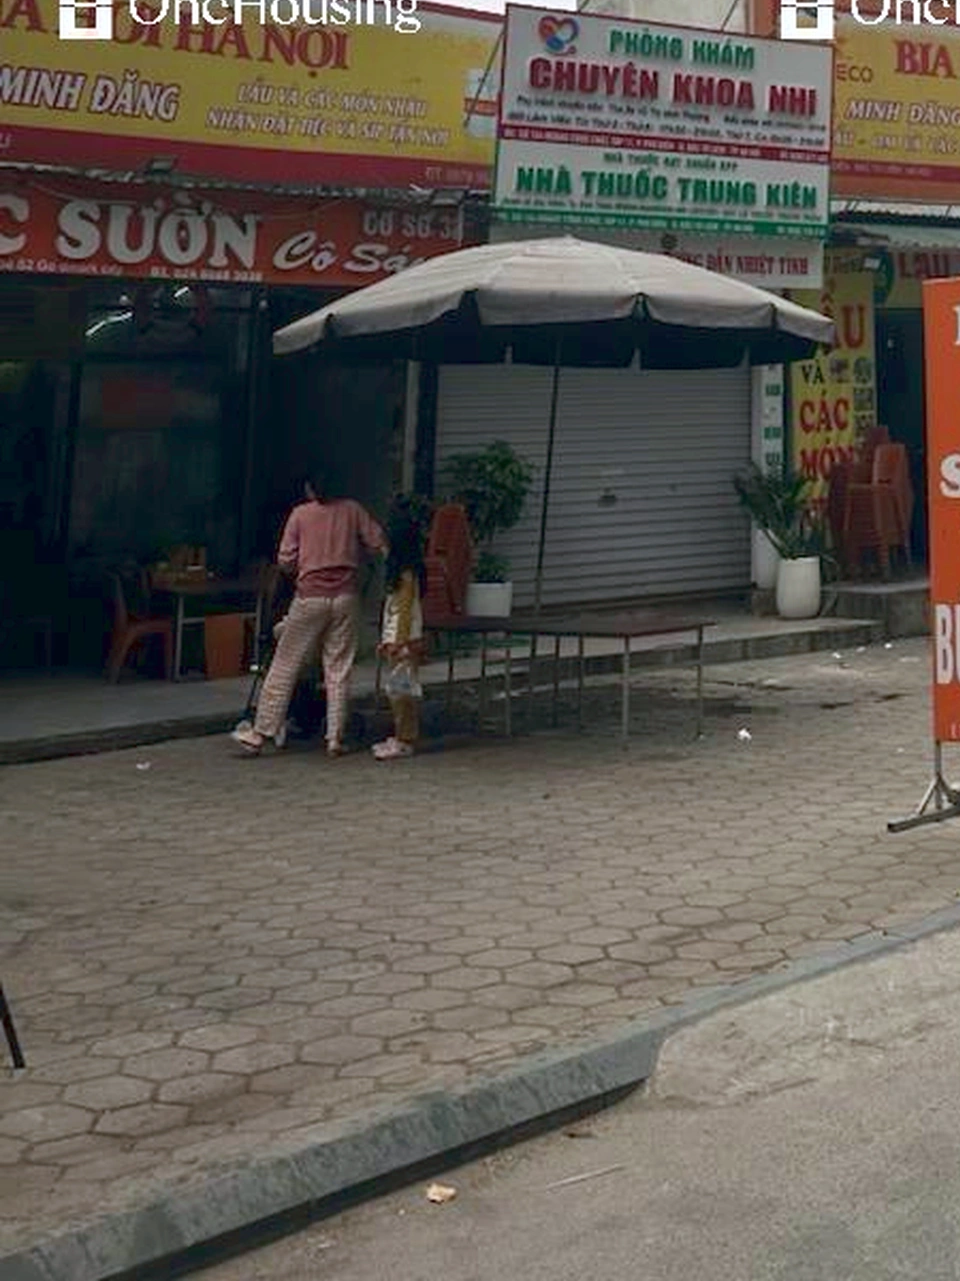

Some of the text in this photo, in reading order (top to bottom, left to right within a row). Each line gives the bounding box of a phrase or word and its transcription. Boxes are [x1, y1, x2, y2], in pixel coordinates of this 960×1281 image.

[258, 27, 349, 78] NỘI
[610, 28, 755, 70] PHÒNG KHÁM
[893, 38, 956, 81] BIA
[0, 66, 180, 120] MINH ĐĂNG
[529, 57, 659, 101] CHUYÊN
[673, 71, 755, 111] KHOA
[768, 84, 817, 117] NHI
[846, 100, 901, 122] MINH
[515, 164, 573, 195] NHÀ
[580, 167, 669, 201] THUỐC
[678, 177, 758, 206] TRUNG
[766, 180, 818, 209] KIÊN
[57, 191, 262, 270] SƯỜN
[273, 231, 338, 271] Cô
[800, 389, 850, 434] CÁC
